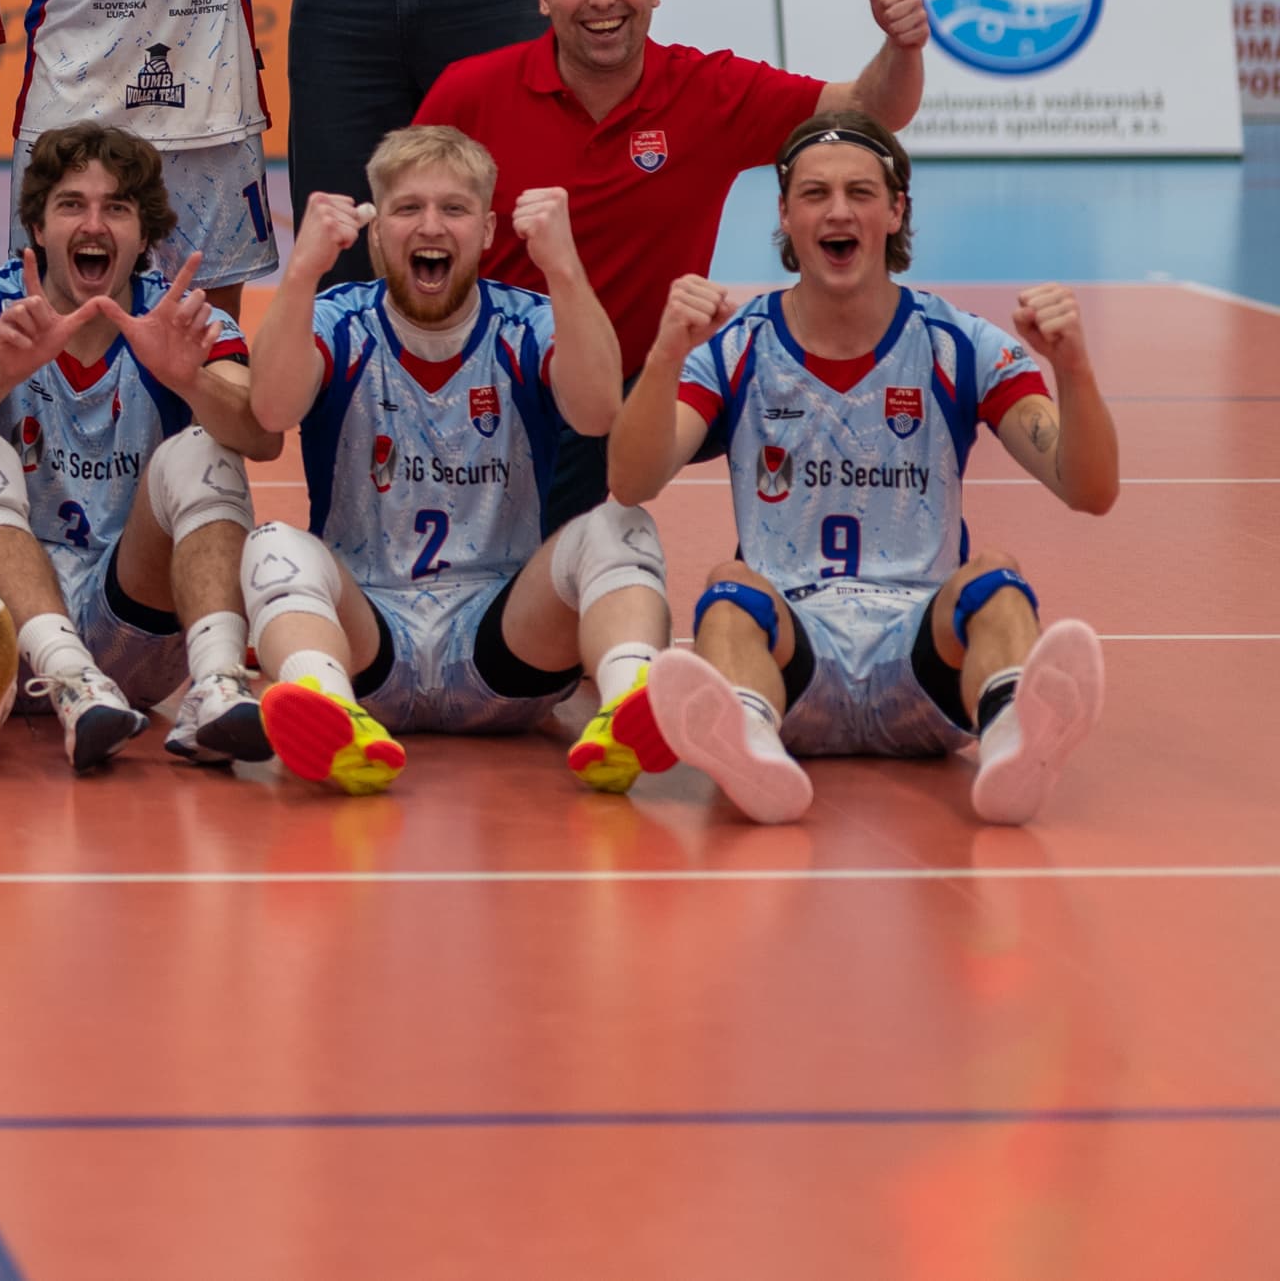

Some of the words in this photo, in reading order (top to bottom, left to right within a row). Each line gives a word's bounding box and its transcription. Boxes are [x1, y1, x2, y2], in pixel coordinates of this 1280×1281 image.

[93, 1, 147, 11] SLOVENSKÁ
[140, 73, 172, 88] UMB
[159, 86, 185, 104] TEAM
[432, 456, 510, 488] Security
[804, 460, 832, 488] SG
[840, 460, 929, 495] Security
[412, 508, 451, 581] 2
[820, 514, 861, 579] 9
